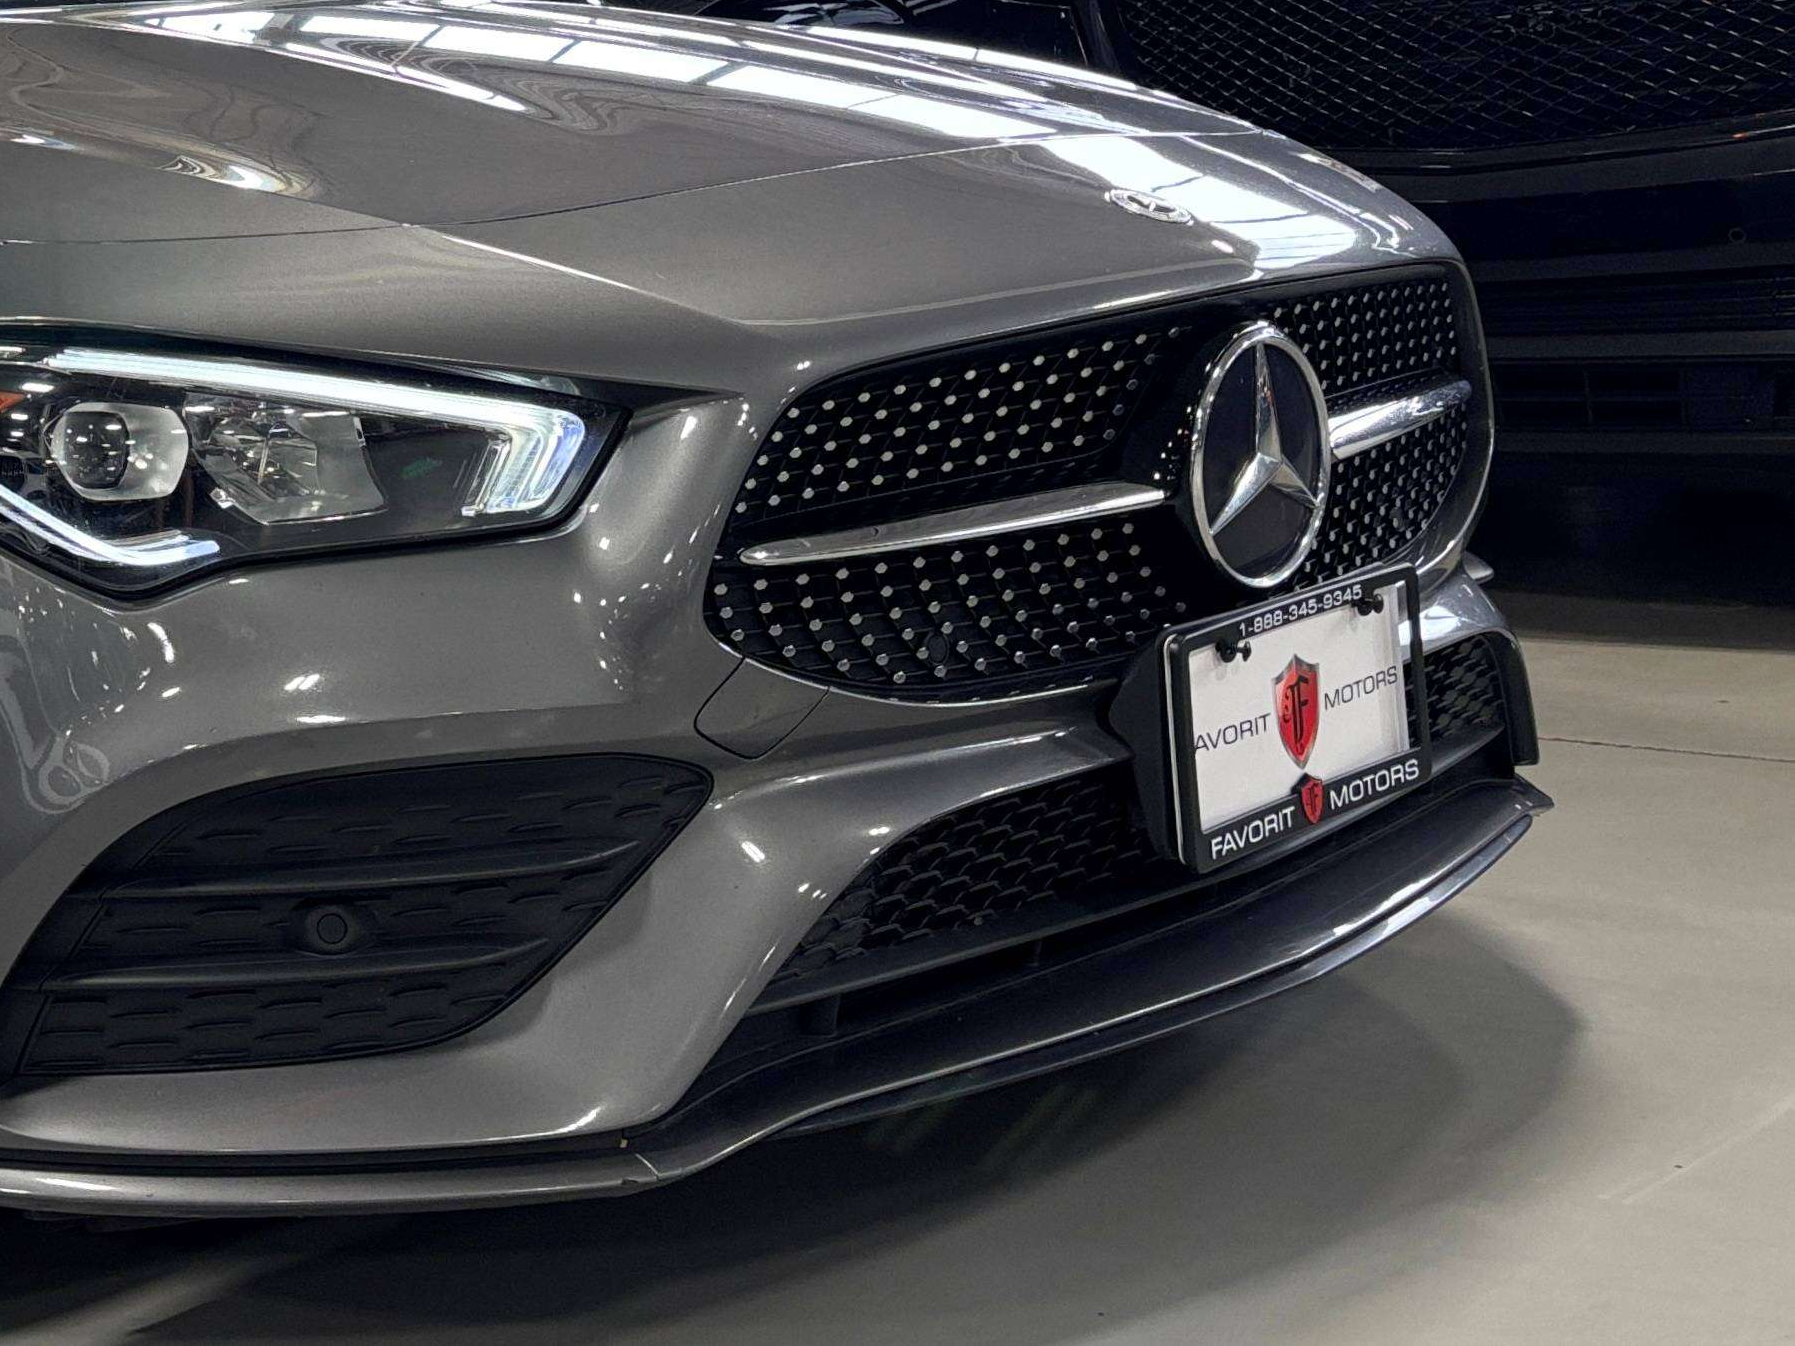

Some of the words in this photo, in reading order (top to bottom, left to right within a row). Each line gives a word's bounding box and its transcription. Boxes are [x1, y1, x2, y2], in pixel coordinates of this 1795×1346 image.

[1239, 585, 1363, 637] 1-888-345-9345
[1194, 713, 1271, 752] AVORIT
[1324, 665, 1399, 711] MOTORS
[1210, 806, 1296, 860] FAVORIT
[1329, 758, 1420, 810] MOTORS
